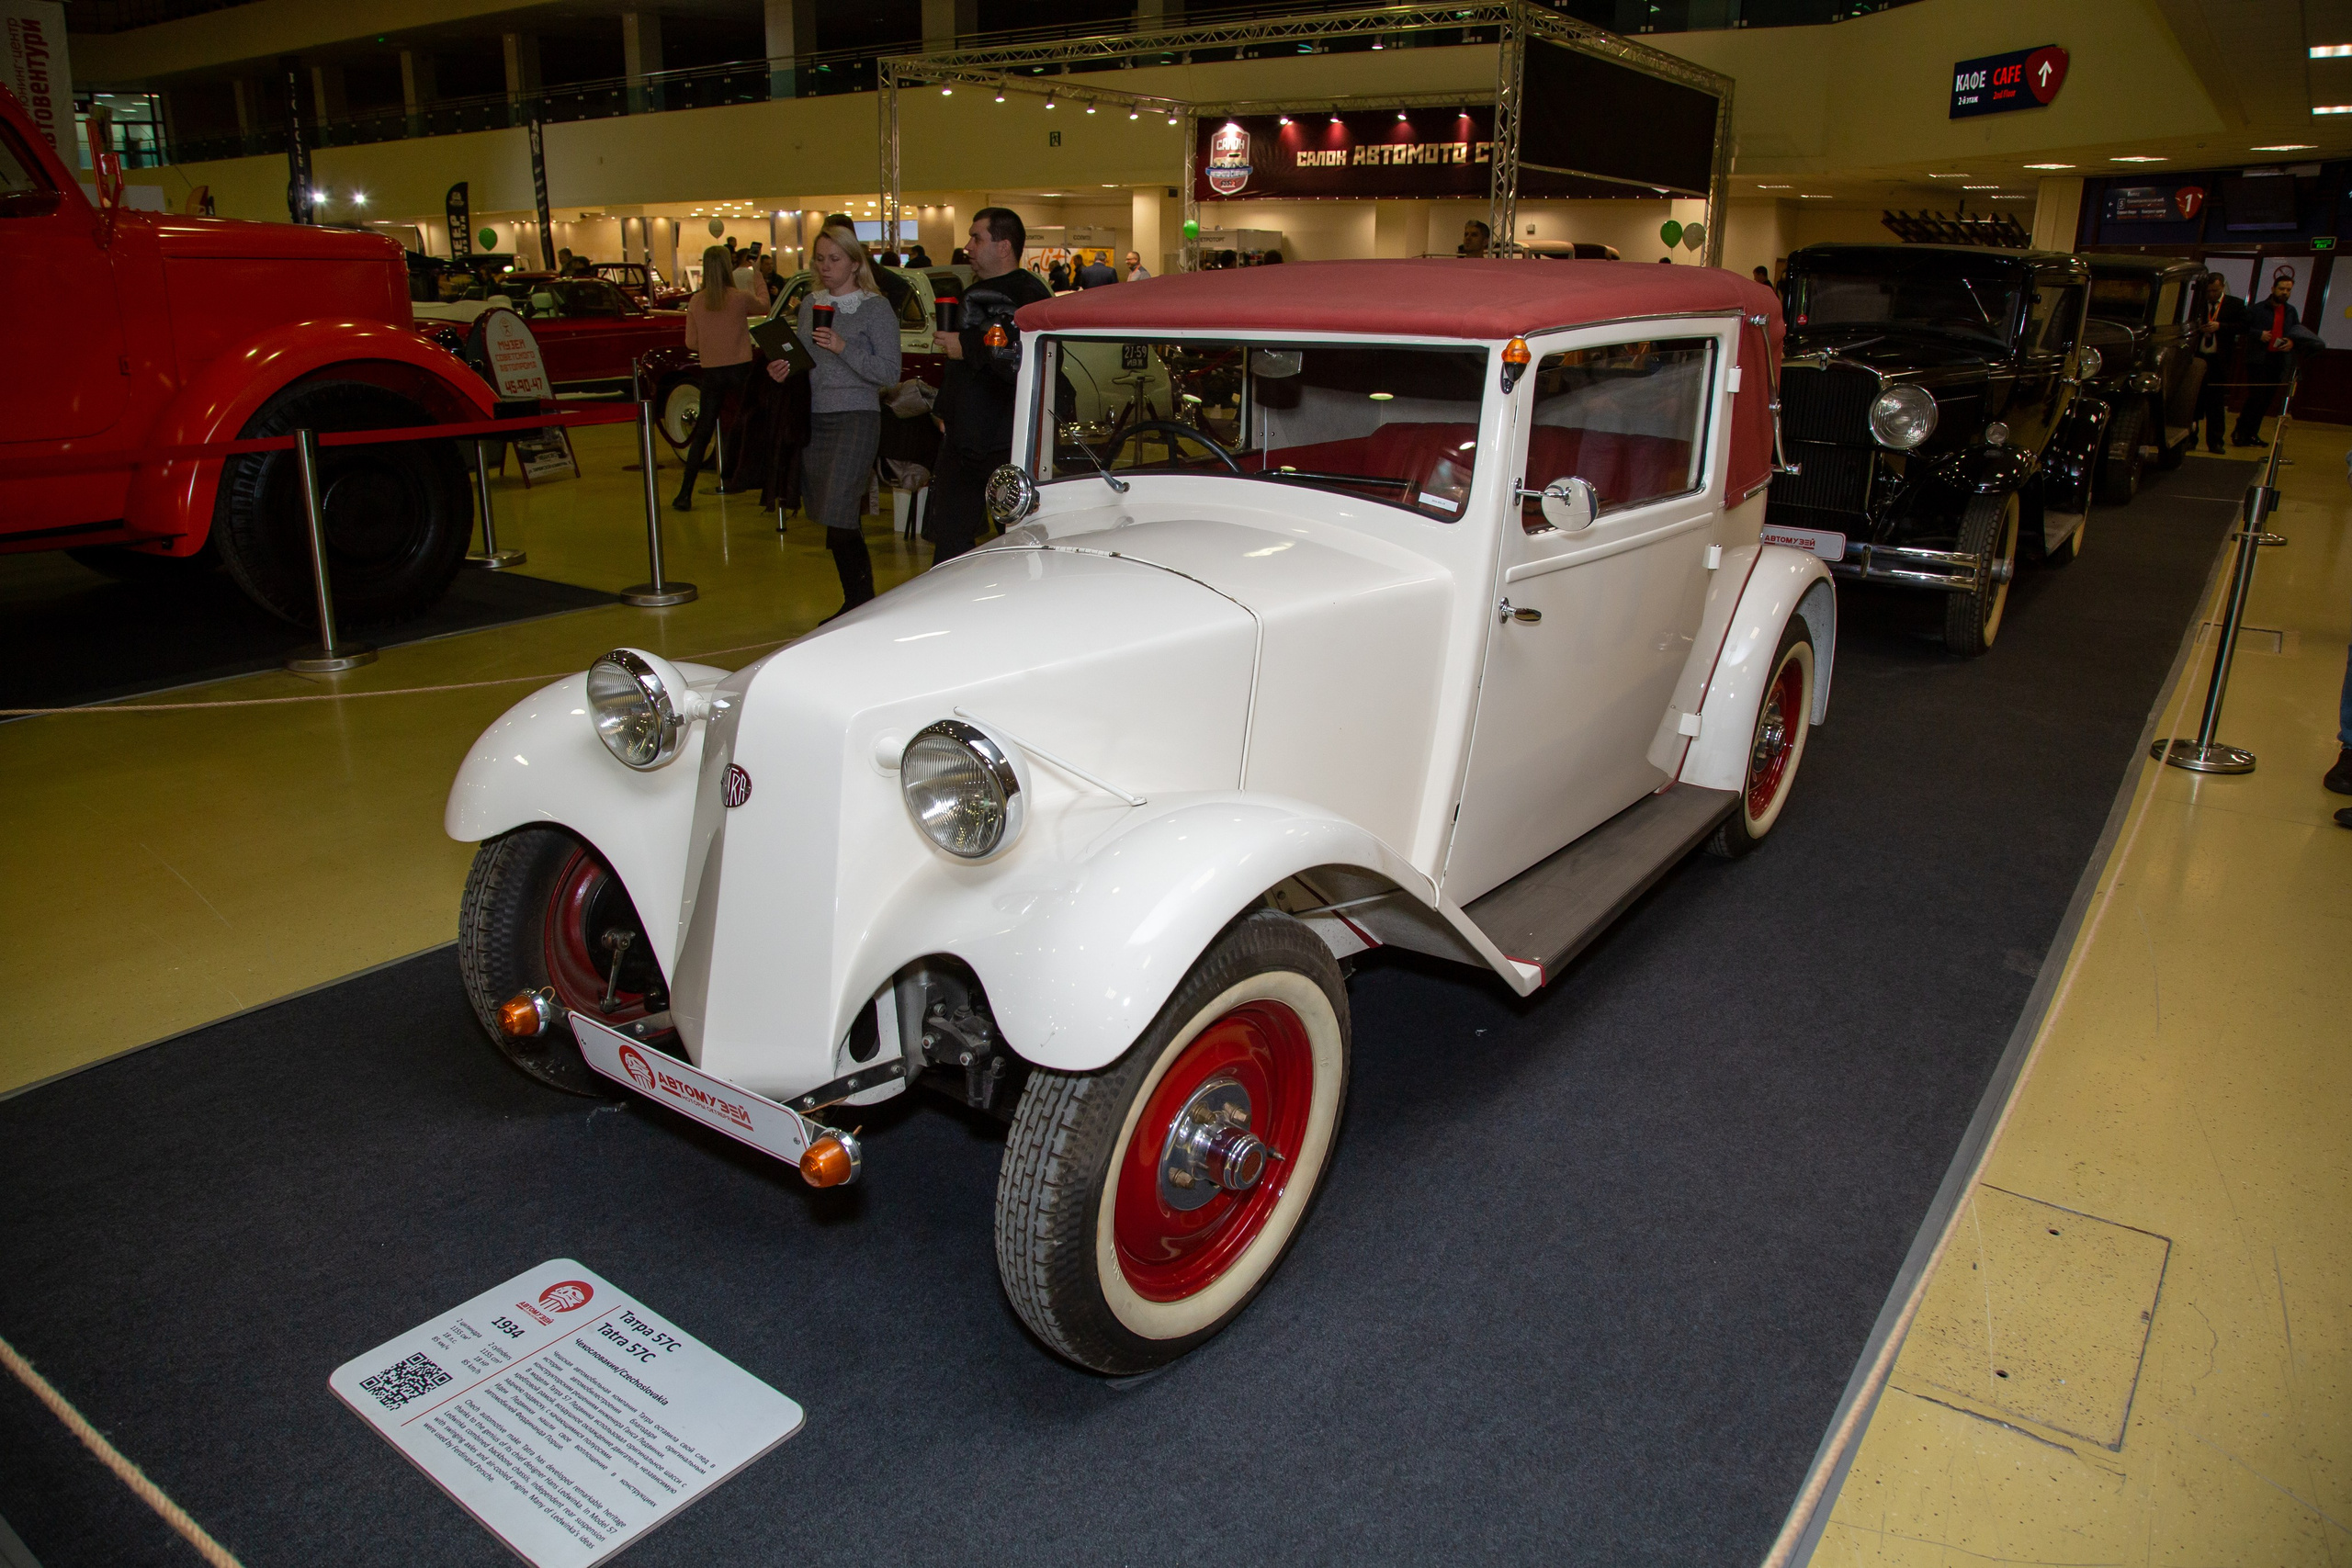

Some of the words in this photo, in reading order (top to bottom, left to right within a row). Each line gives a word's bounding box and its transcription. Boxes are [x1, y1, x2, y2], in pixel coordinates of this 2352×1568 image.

[21, 18, 57, 150] втовентури
[1955, 70, 1986, 92] КАФЕ
[1993, 64, 2022, 86] CAFE
[1993, 90, 2003, 100] 2nd
[2003, 89, 2017, 98] Floor
[1296, 150, 1347, 167] САЛОН
[1352, 141, 1467, 166] АВТОМОТО
[1475, 141, 1507, 164] СТ
[459, 215, 469, 253] USTOM
[495, 350, 536, 362] СОВЕТСКОГО
[1125, 345, 1148, 359] 21-59
[504, 377, 543, 394] 45-90-47
[1765, 535, 1815, 547] АВТОМУЗЕЙ
[658, 1071, 752, 1123] АВТОМУЗЕЙ
[491, 1316, 525, 1338] 1934
[519, 1301, 554, 1325] АВТОМУЗЕЙ
[597, 1322, 628, 1347] Tatra
[626, 1343, 656, 1363] 57C
[619, 1310, 654, 1337] Татра
[650, 1333, 682, 1352] 57C
[423, 1422, 436, 1434] were
[434, 1431, 449, 1443] used
[445, 1439, 454, 1449] by
[451, 1445, 478, 1467] Ferdinand
[473, 1463, 494, 1483] Porsche.
[464, 1399, 481, 1413] Chech
[479, 1412, 507, 1434] automotive
[506, 1433, 522, 1445] make
[521, 1443, 536, 1456] Tatra
[535, 1454, 546, 1465] has
[545, 1464, 574, 1486] developed
[572, 1485, 603, 1509] remarkable
[603, 1508, 627, 1528] heritage
[434, 1416, 447, 1427] with
[444, 1426, 466, 1444] swinging
[463, 1442, 478, 1453] axles
[476, 1452, 490, 1461] and
[486, 1461, 513, 1481] air-cooled
[510, 1480, 528, 1496] engine.
[528, 1494, 546, 1509] Many
[550, 1512, 580, 1537] Ledwinka's
[578, 1535, 594, 1550] ideas
[444, 1410, 467, 1429] Ledwinka
[465, 1428, 491, 1448] combined
[488, 1446, 513, 1467] backbone
[511, 1466, 530, 1483] chassis,
[530, 1481, 564, 1508] independent
[562, 1507, 576, 1517] rear
[574, 1517, 605, 1542] suspension
[454, 1404, 471, 1419] thanks
[474, 1421, 485, 1430] the
[481, 1428, 500, 1442] genius
[511, 1450, 527, 1462] chief
[523, 1461, 546, 1479] designer
[544, 1476, 559, 1490] Hans
[557, 1487, 582, 1509] Ledwinka.
[582, 1506, 591, 1515] In
[589, 1512, 610, 1529] Model
[605, 1526, 617, 1534] 57
